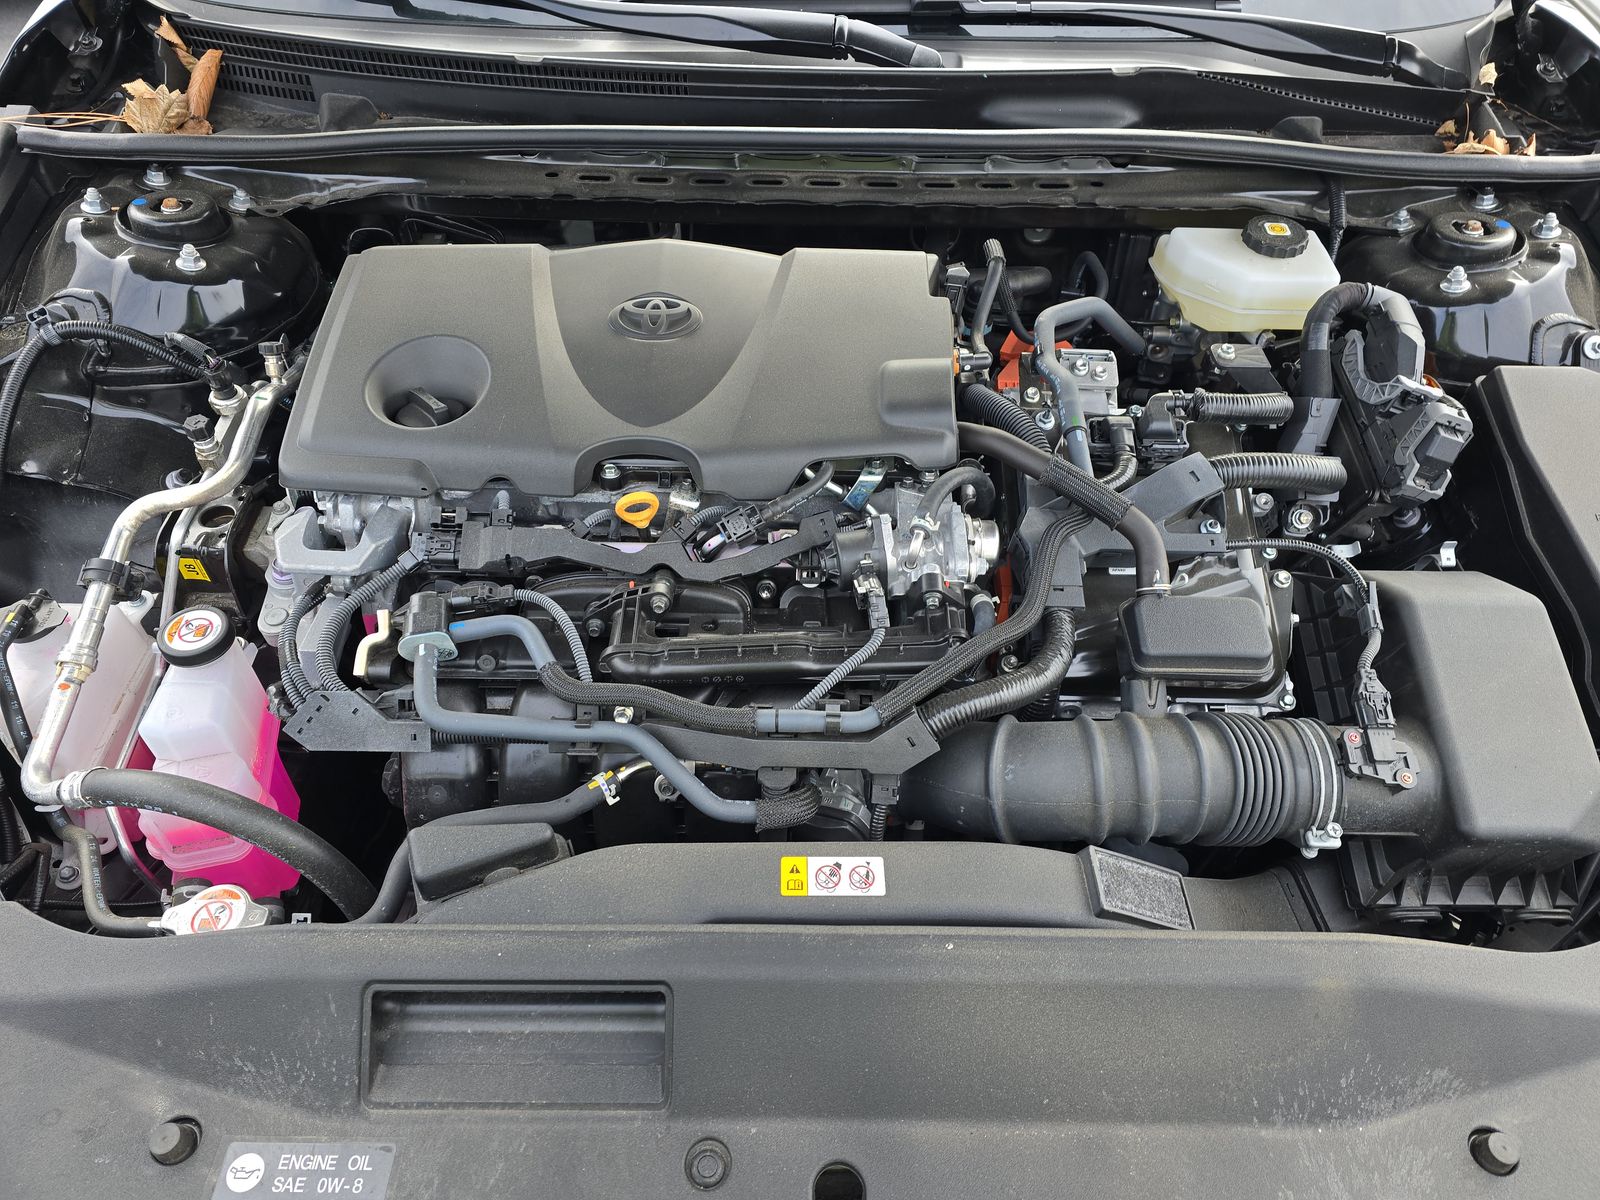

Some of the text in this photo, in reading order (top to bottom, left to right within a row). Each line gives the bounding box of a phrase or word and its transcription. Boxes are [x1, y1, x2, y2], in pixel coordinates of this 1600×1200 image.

[184, 564, 199, 575] J8
[277, 1154, 373, 1171] ENGINE OIL
[271, 1176, 364, 1193] SAE 0W-8
